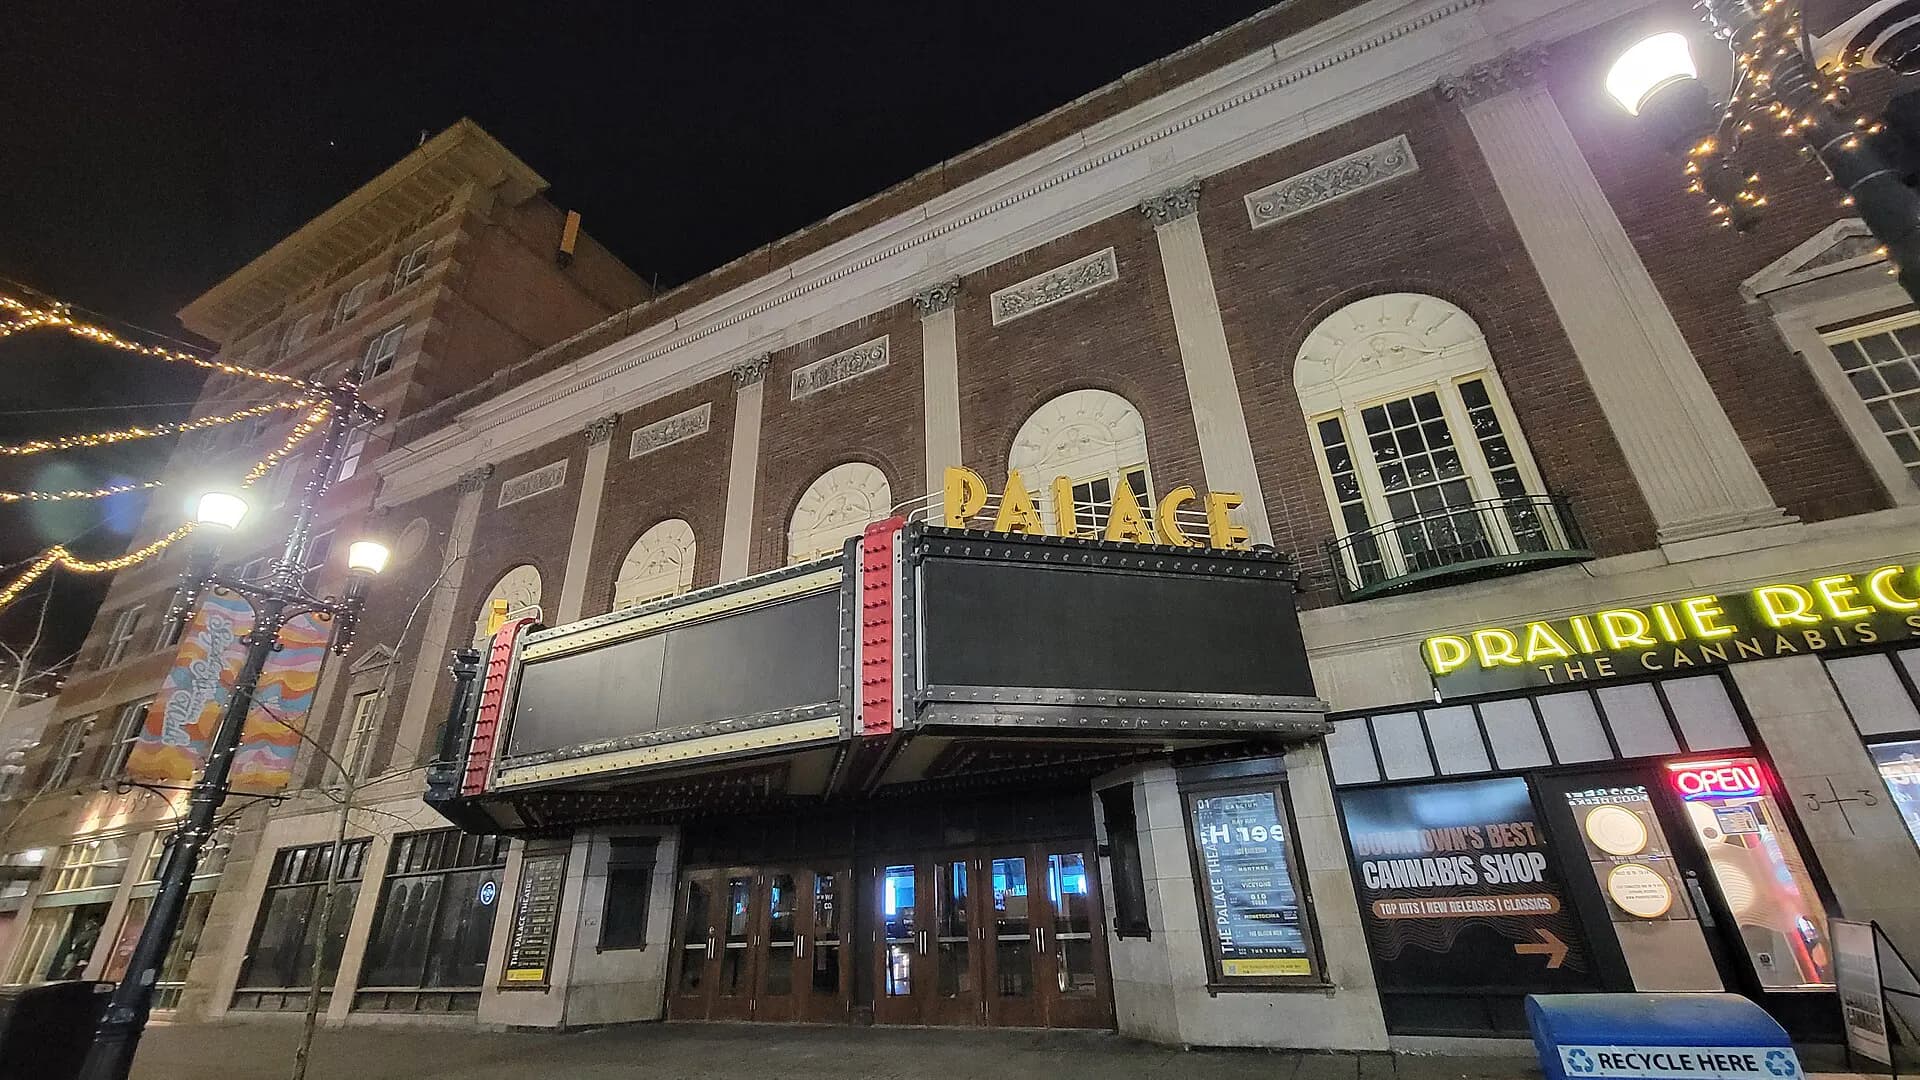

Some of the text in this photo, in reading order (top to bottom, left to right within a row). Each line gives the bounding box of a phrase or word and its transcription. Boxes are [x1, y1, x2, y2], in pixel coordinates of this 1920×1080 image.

[944, 466, 1253, 551] PALACE
[1427, 565, 1920, 676] PRAIRIE REC
[1539, 657, 1616, 684] THE
[1641, 622, 1879, 672] CANNABIS
[1677, 765, 1761, 793] OPEN
[1357, 821, 1539, 855] DOWNOWN'S BEST
[1362, 852, 1547, 889] CANNABIS SHOP
[1211, 877, 1230, 925] PALACE
[1380, 897, 1552, 915] TOP HITS NEW RELEASES CLASSICS
[515, 916, 526, 947] PALACE
[1219, 928, 1235, 954] THE
[1597, 1052, 1760, 1072] RECYCLE HERE
